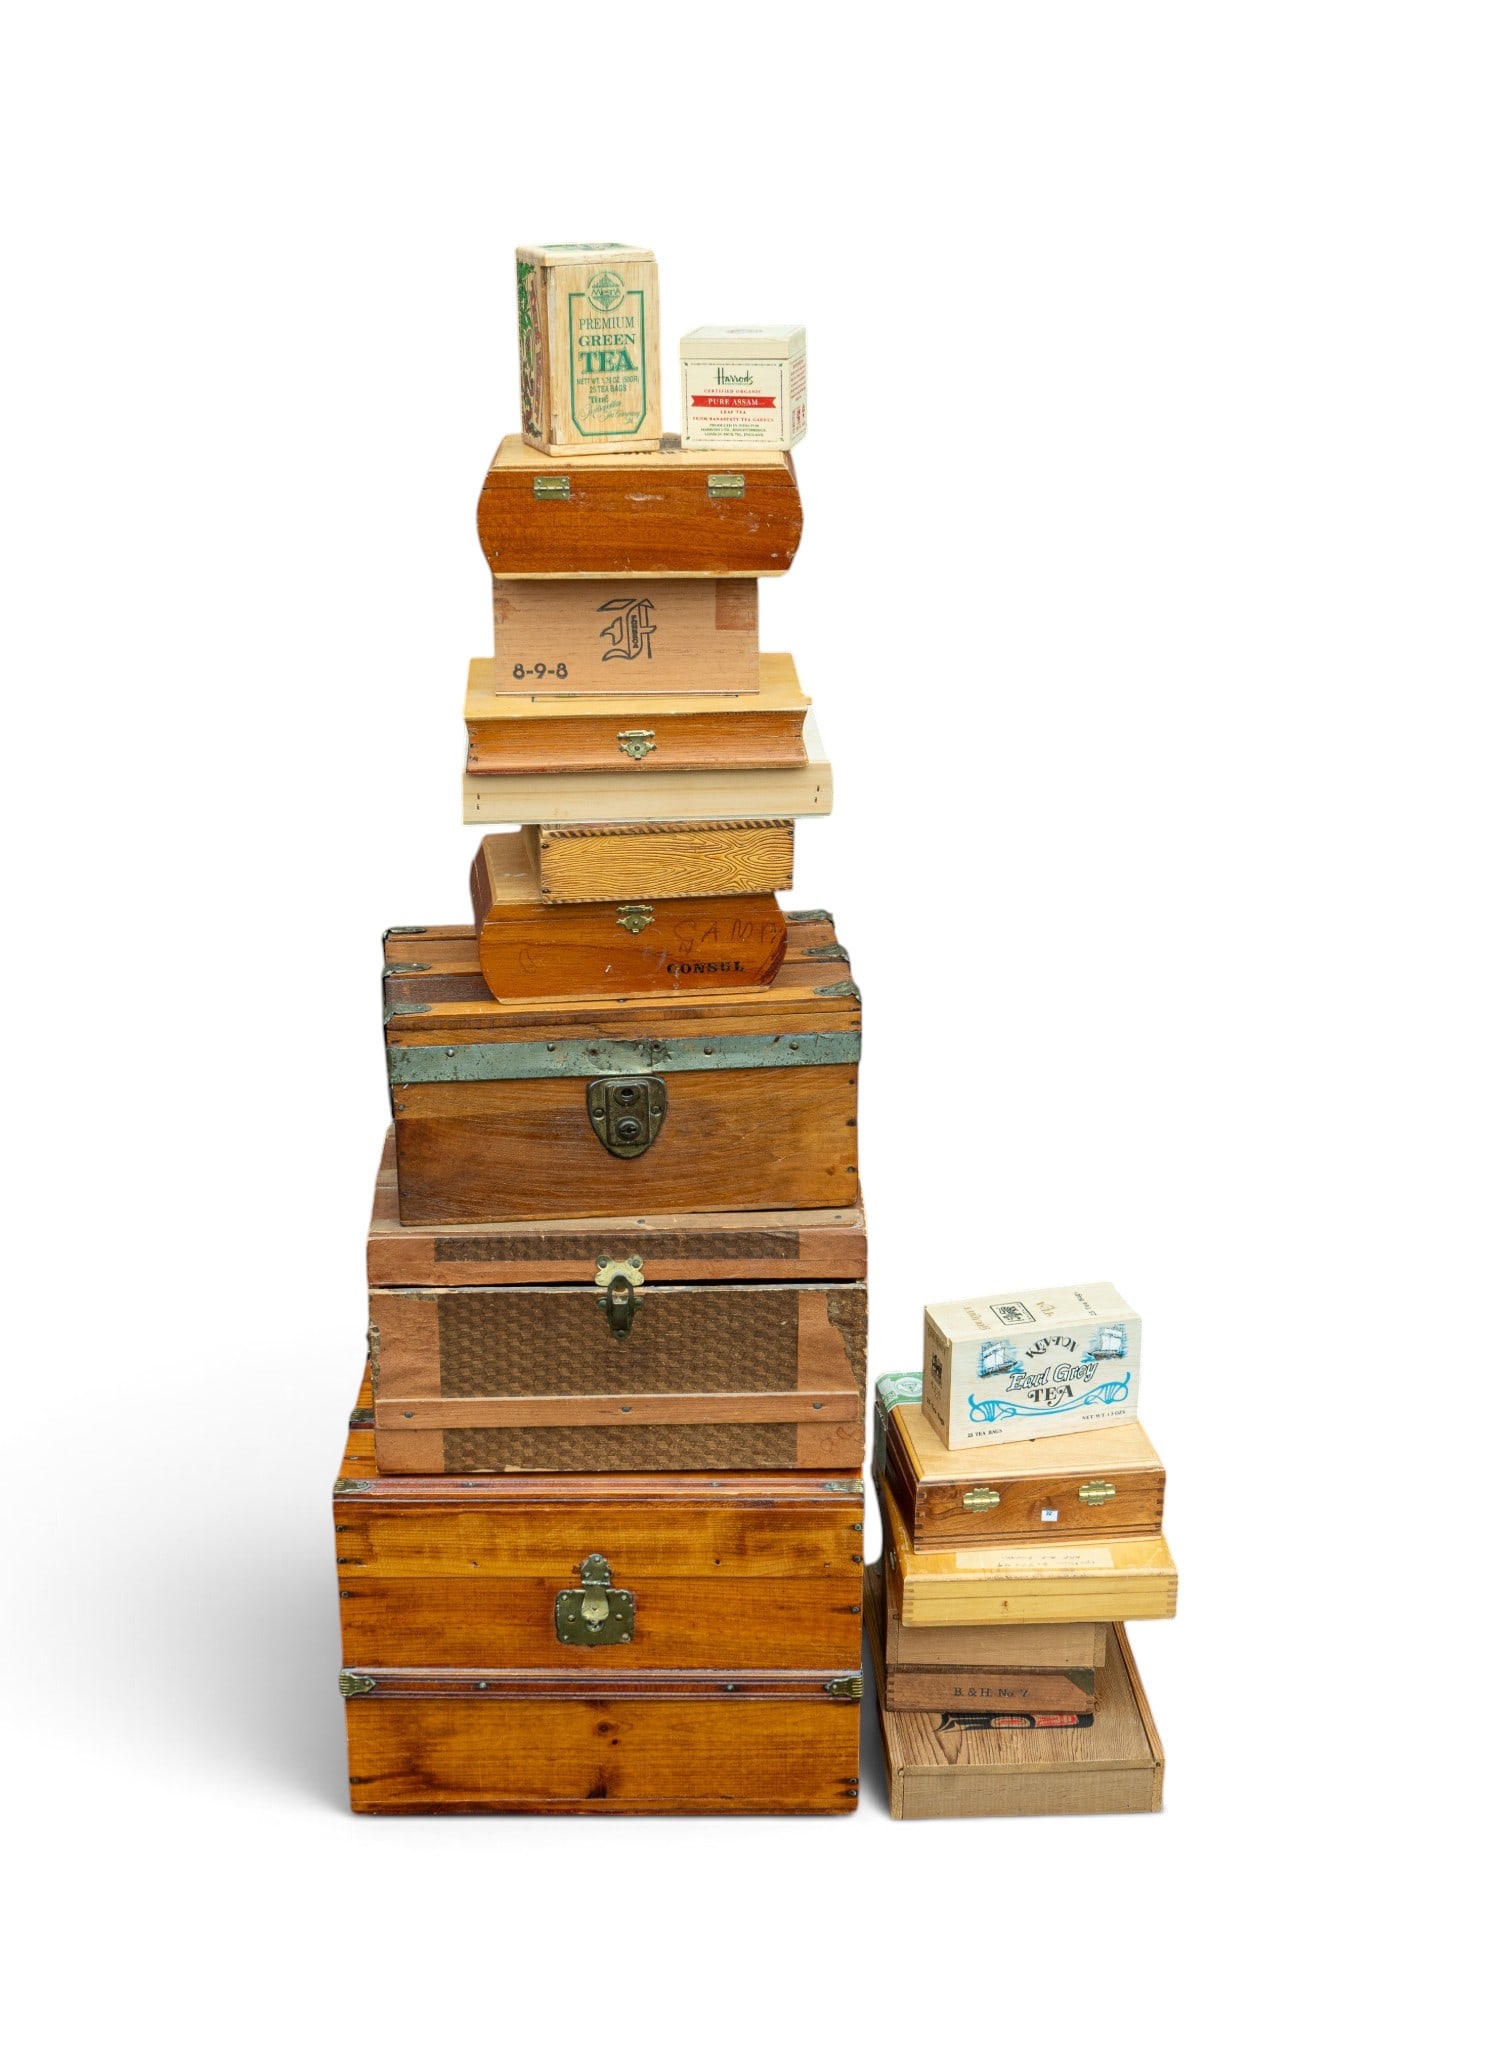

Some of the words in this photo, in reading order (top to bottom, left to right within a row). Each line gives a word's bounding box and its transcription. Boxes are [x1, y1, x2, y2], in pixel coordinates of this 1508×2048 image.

[579, 316, 635, 330] PREMIUM
[578, 333, 636, 347] GREEN
[578, 348, 638, 375] TEA
[714, 367, 754, 385] Harrods
[610, 384, 627, 392] BAGS
[512, 662, 569, 680] 8-9-8
[666, 961, 746, 975] CONSUL
[1006, 1366, 1051, 1392] Earl
[1053, 1363, 1099, 1383] Grey
[1028, 1384, 1073, 1407] TEA
[967, 1687, 977, 1697] &
